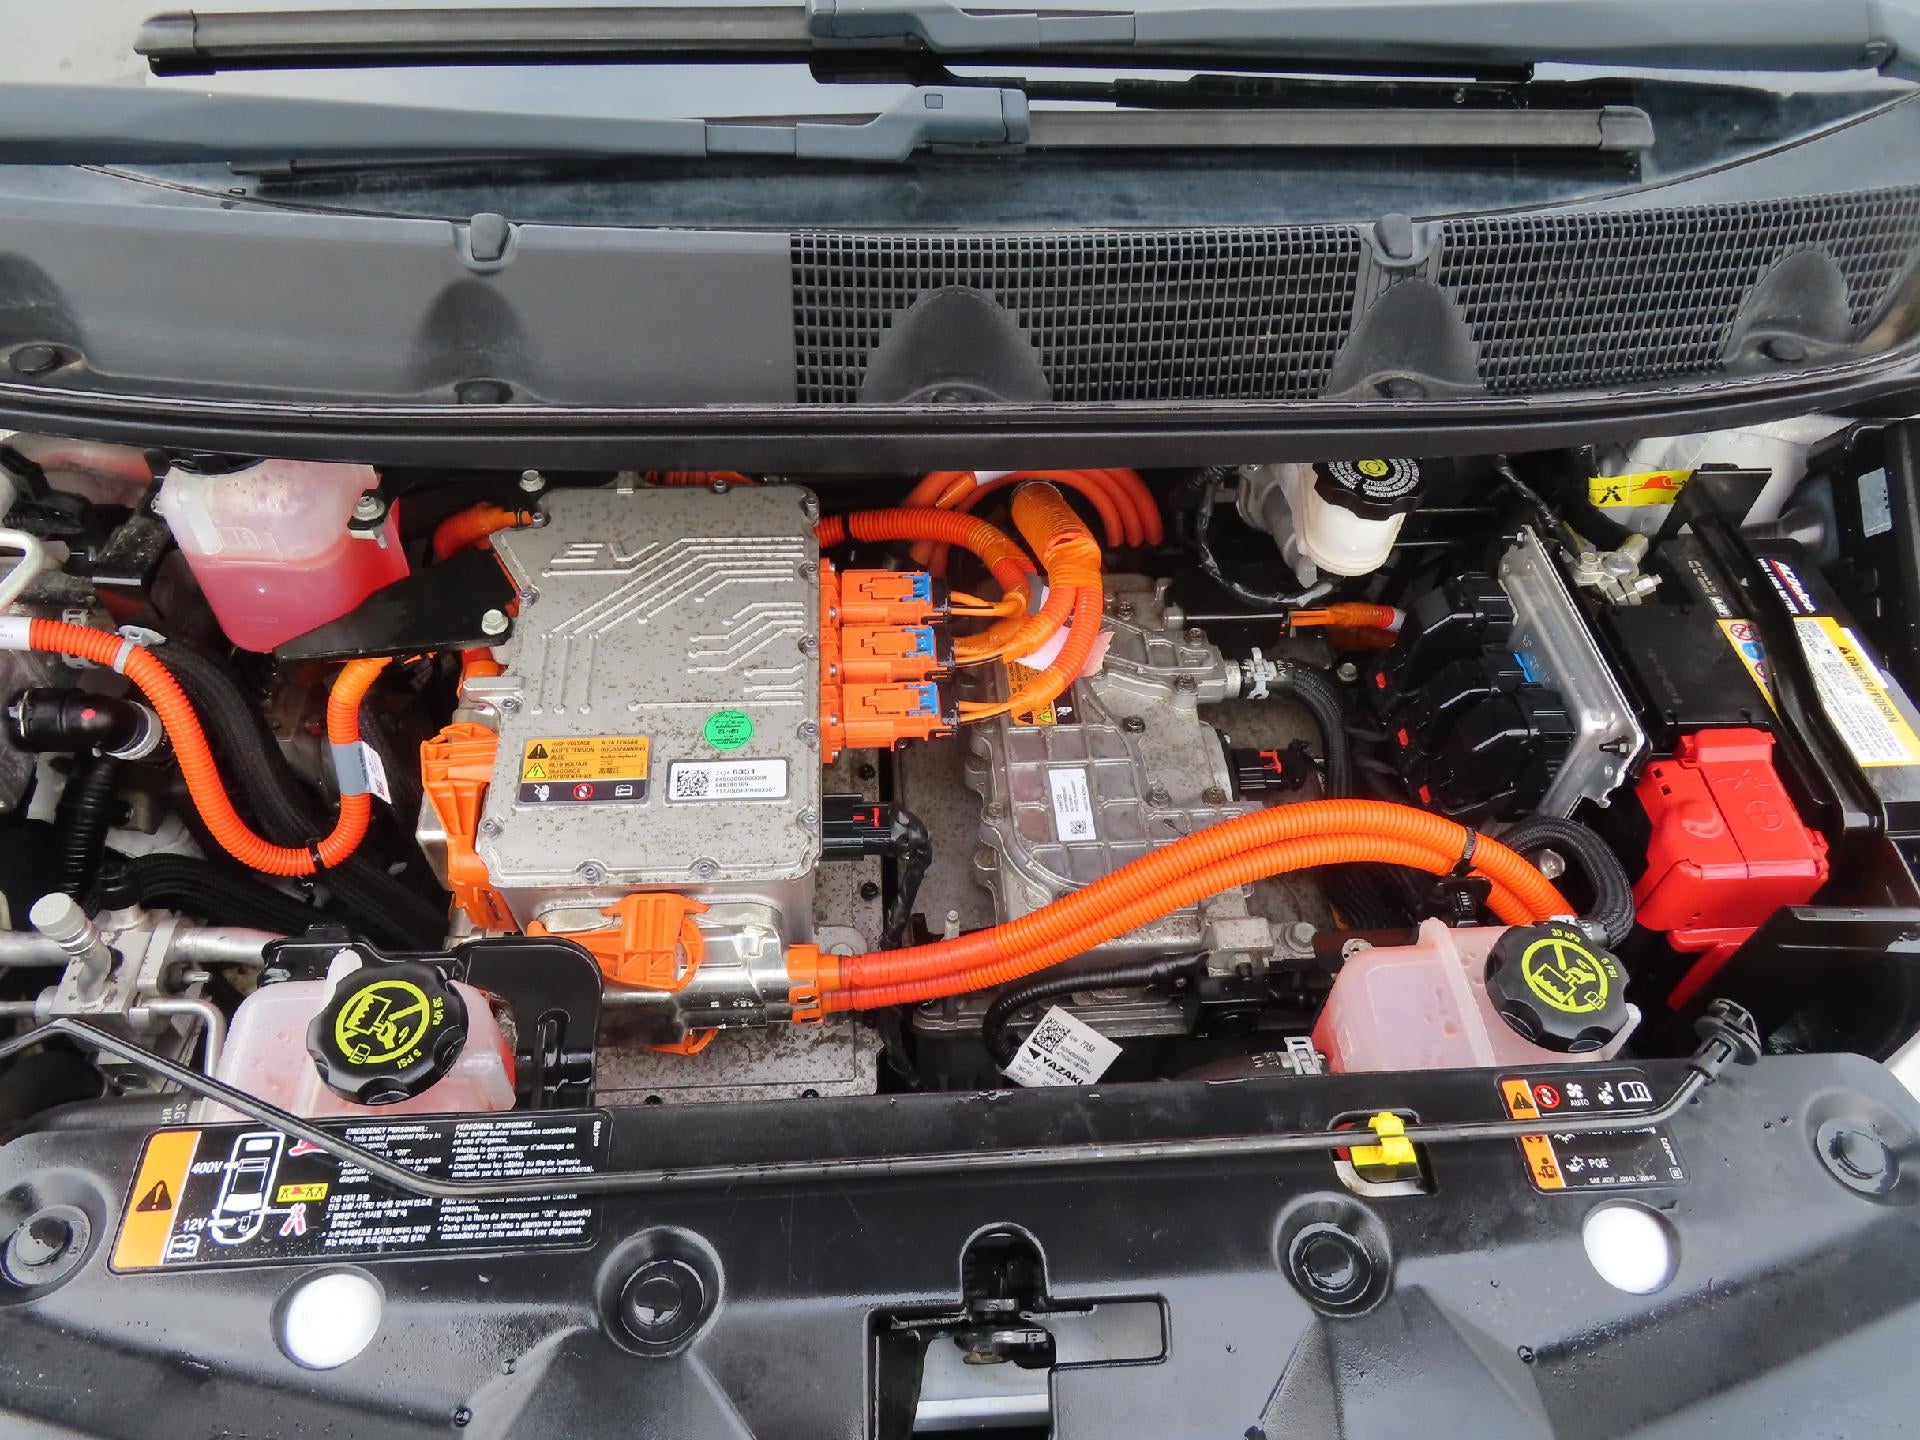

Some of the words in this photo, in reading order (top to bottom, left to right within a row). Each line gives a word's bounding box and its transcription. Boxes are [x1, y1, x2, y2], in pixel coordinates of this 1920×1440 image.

[1551, 928, 1563, 937] 35
[1565, 931, 1582, 943] kPa
[1605, 965, 1619, 978] PSI
[432, 1009, 444, 1026] kPa
[413, 1048, 422, 1058] 5
[397, 1054, 415, 1070] PSI
[1043, 1055, 1084, 1086] YAZAKI
[1570, 1099, 1590, 1107] AUTO
[346, 1127, 387, 1135] EMERGENCY
[456, 1122, 494, 1130] PERSONNEL
[541, 1127, 577, 1135] corporelles
[386, 1133, 414, 1141] personal
[415, 1132, 434, 1140] injury
[190, 1161, 225, 1174] 400V
[1588, 1158, 1609, 1169] POE
[182, 1218, 208, 1232] 12V
